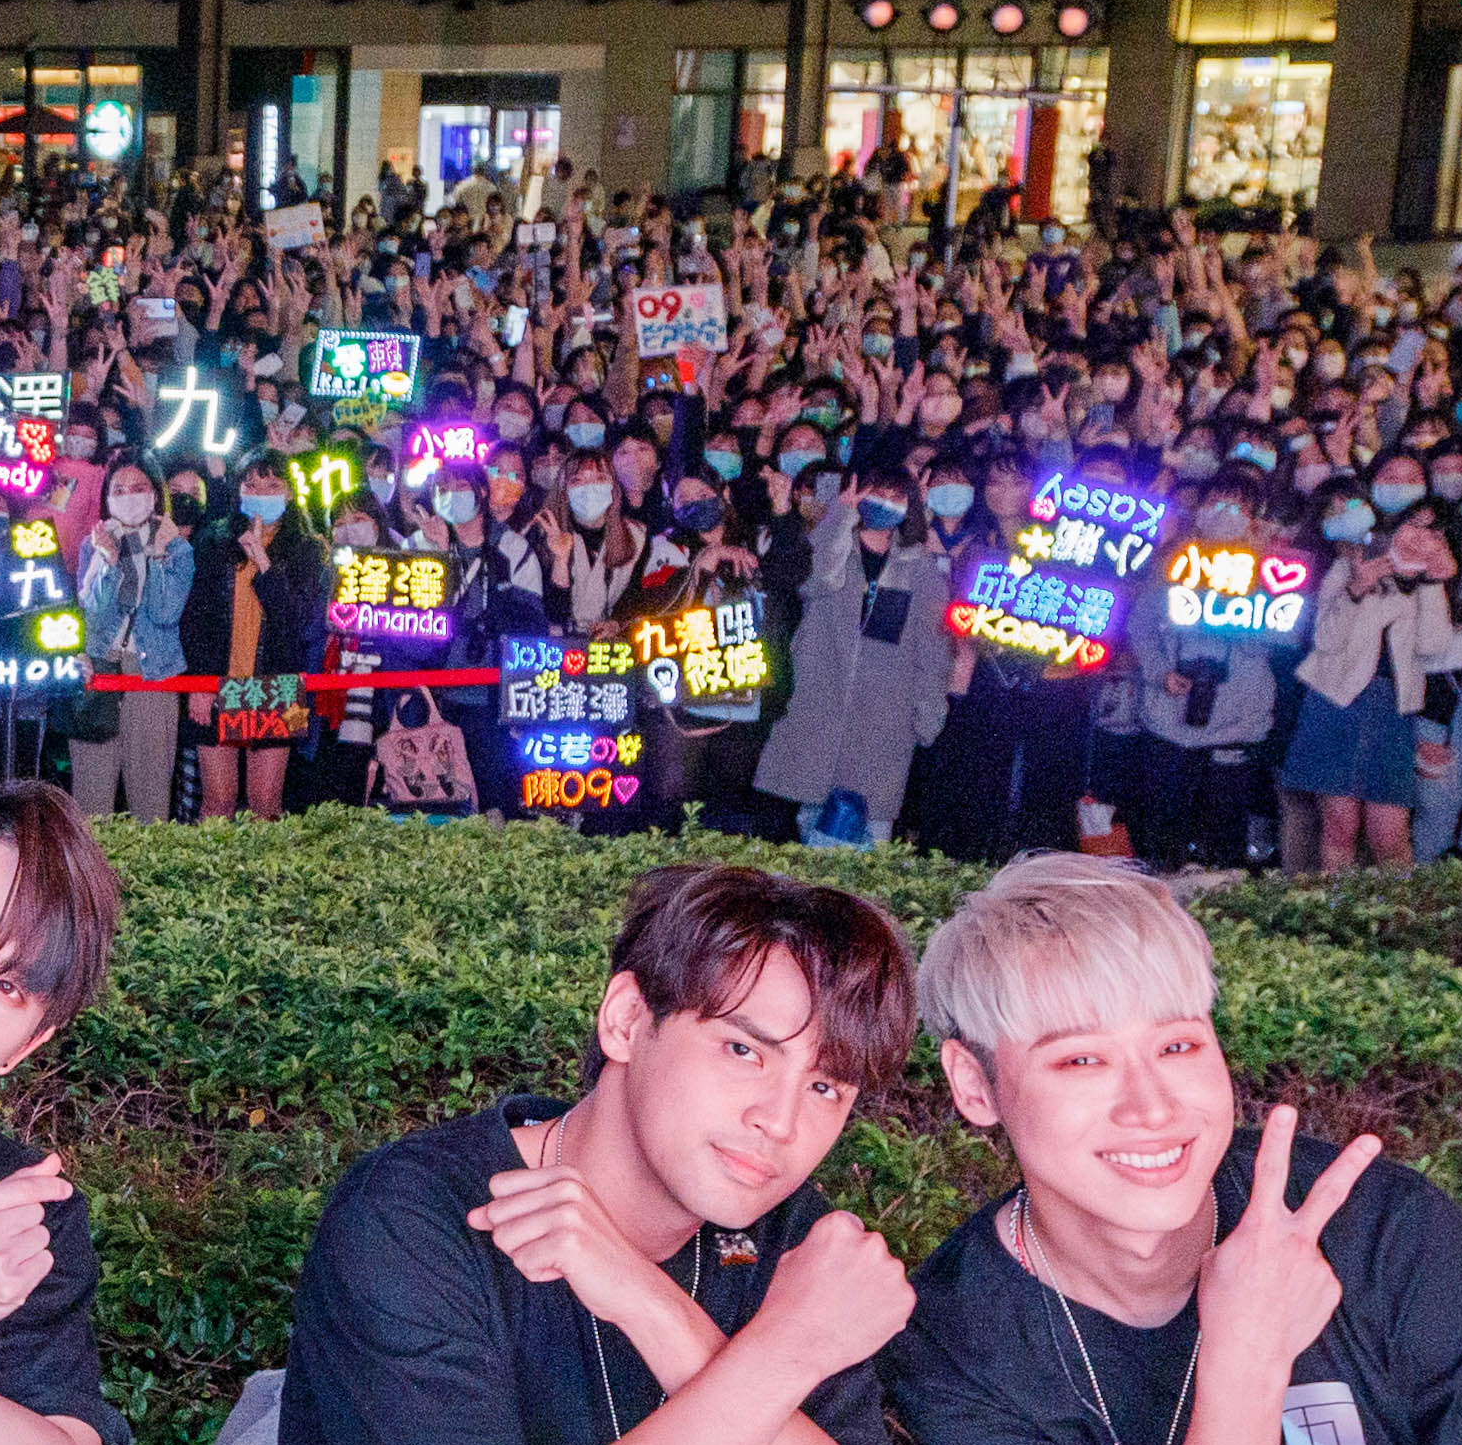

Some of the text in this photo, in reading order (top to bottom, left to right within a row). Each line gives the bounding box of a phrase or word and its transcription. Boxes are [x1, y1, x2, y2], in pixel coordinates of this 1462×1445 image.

[638, 290, 682, 323] 09
[155, 366, 237, 453] 九
[337, 554, 445, 610] 鋒澤
[357, 602, 447, 636] Amanda
[586, 642, 634, 674] 王子
[506, 681, 629, 722] 邱鋒澤
[522, 768, 612, 807] 陳09
